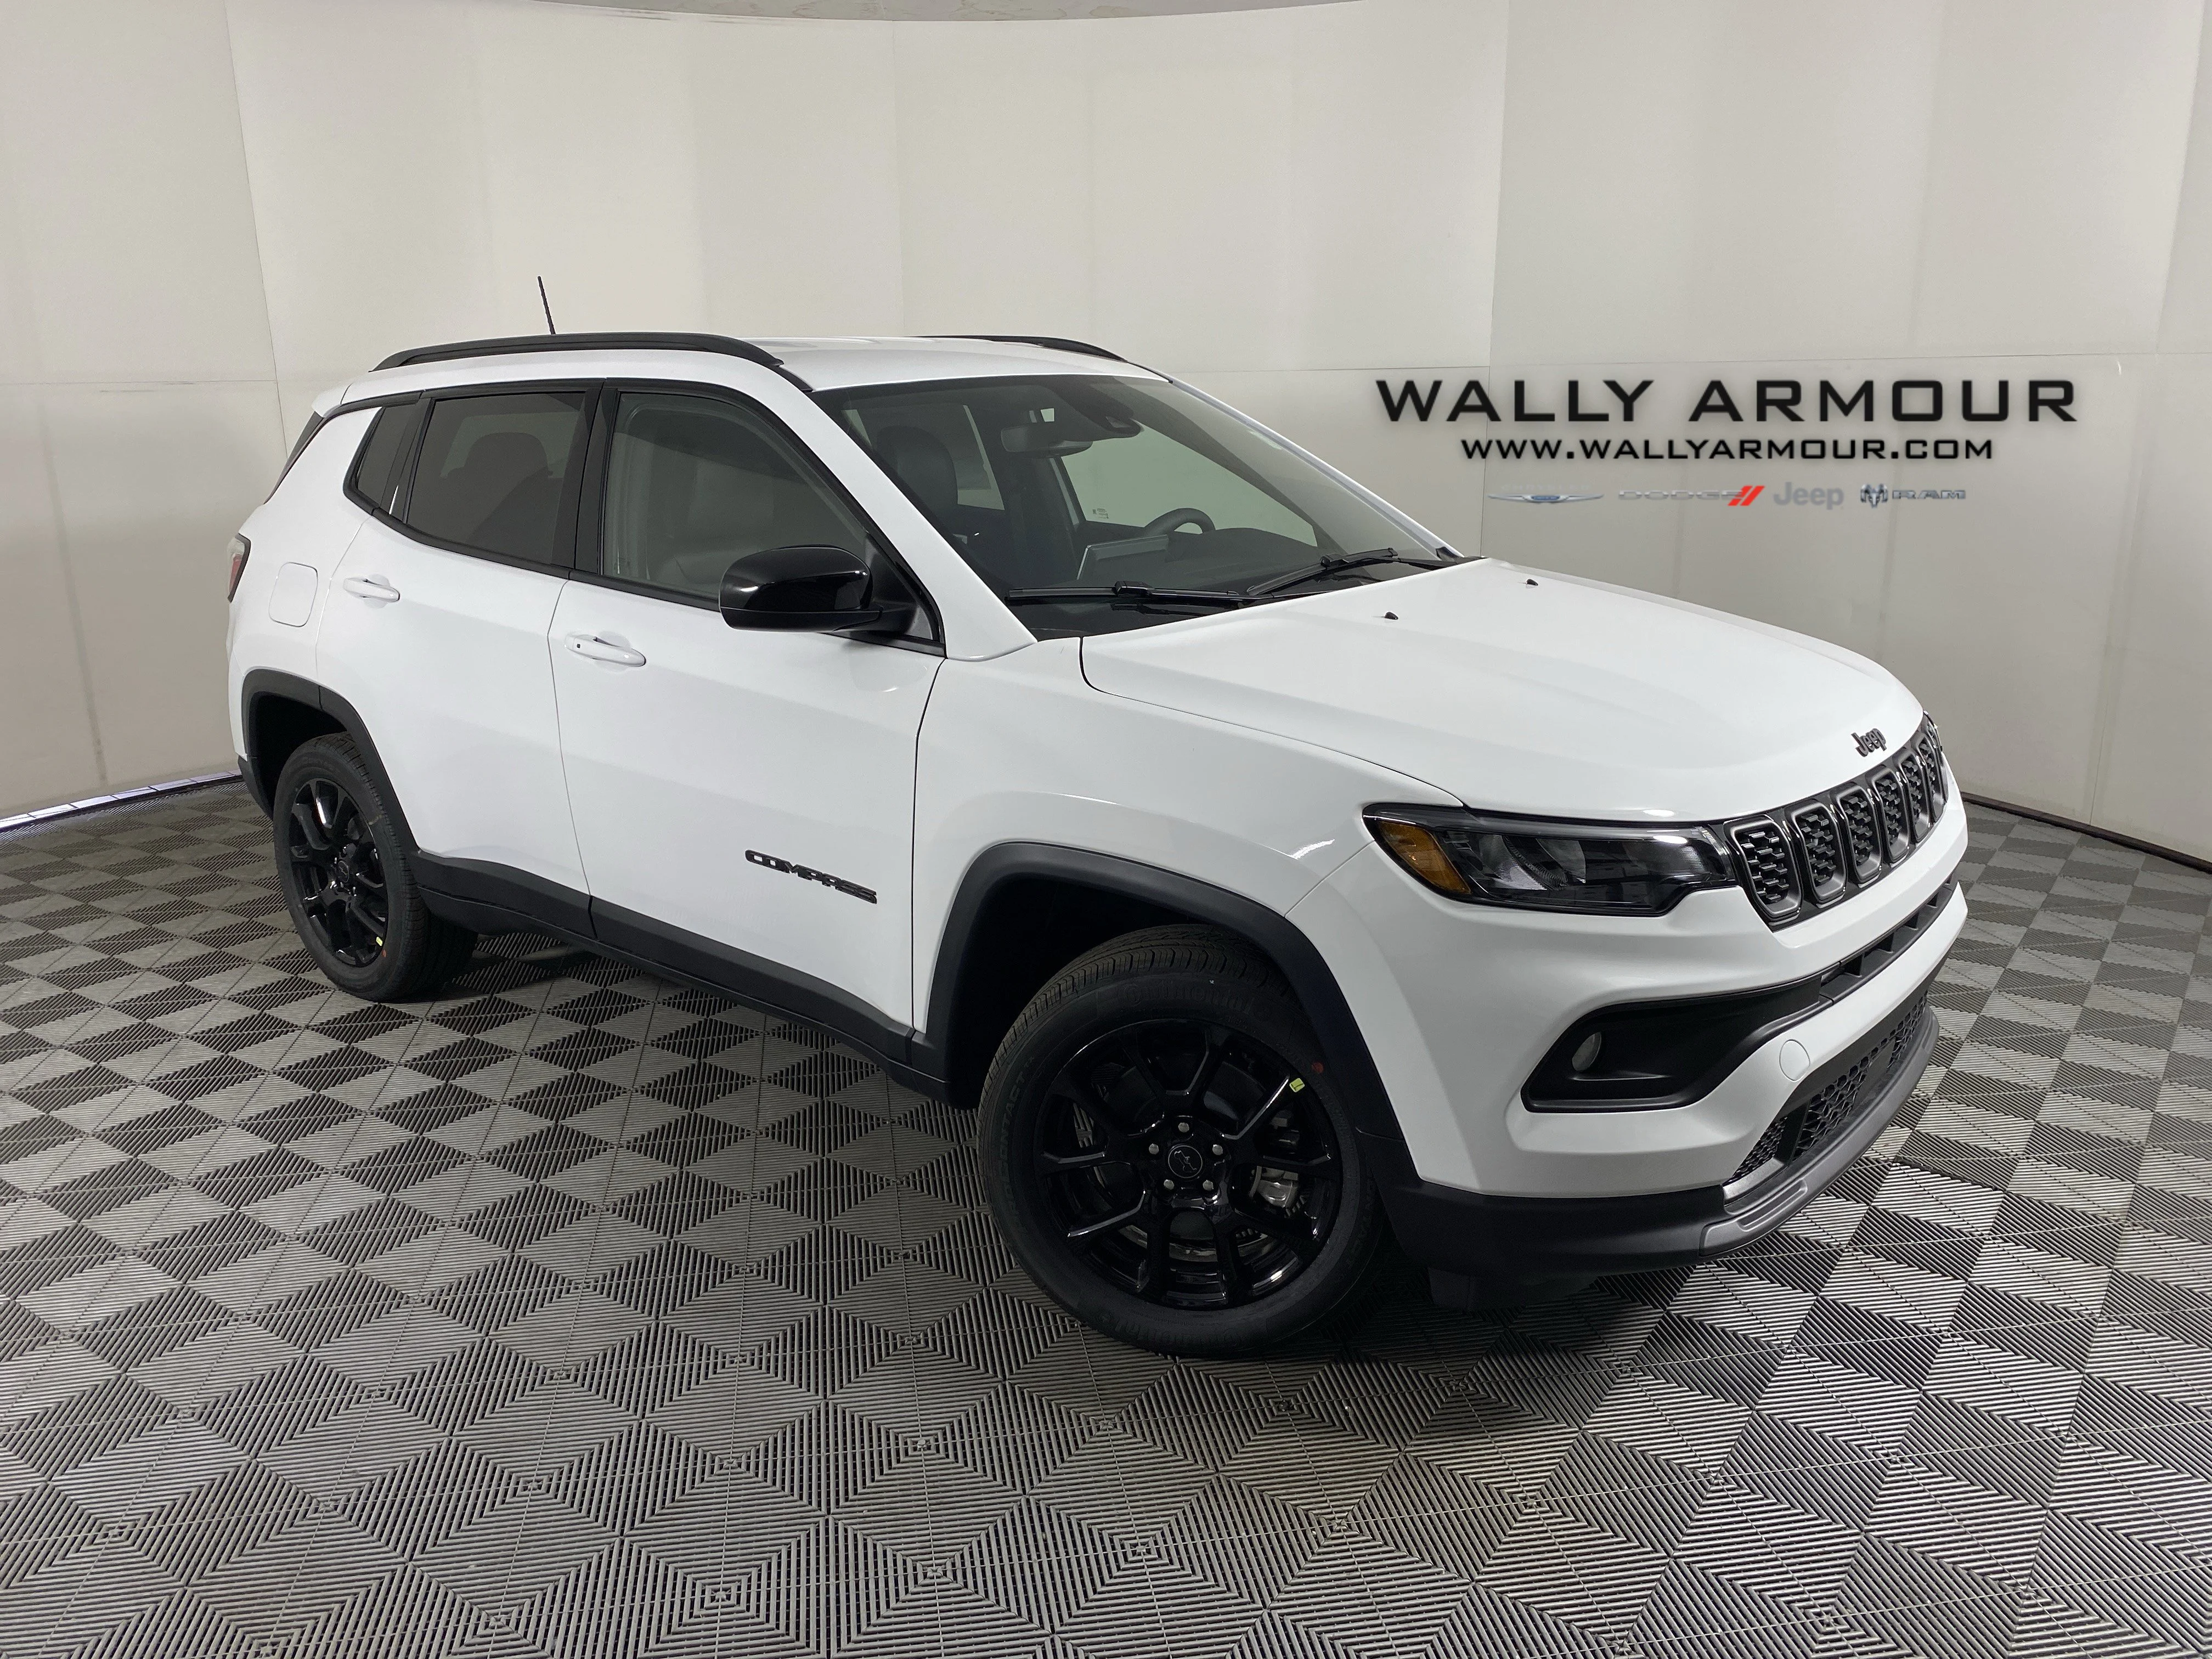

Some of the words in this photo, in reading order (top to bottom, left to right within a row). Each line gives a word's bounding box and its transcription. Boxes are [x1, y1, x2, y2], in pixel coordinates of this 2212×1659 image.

[1375, 380, 1655, 421] WALLY
[1688, 380, 2078, 421] ARMOUR
[1461, 439, 1993, 459] WWW.WALLYARMOUR.COM
[1618, 489, 1743, 500] DODGE
[1773, 482, 1844, 510] Jeep
[1892, 489, 1966, 499] RAM
[1850, 728, 1887, 757] Jeep
[745, 850, 877, 904] COMPASS
